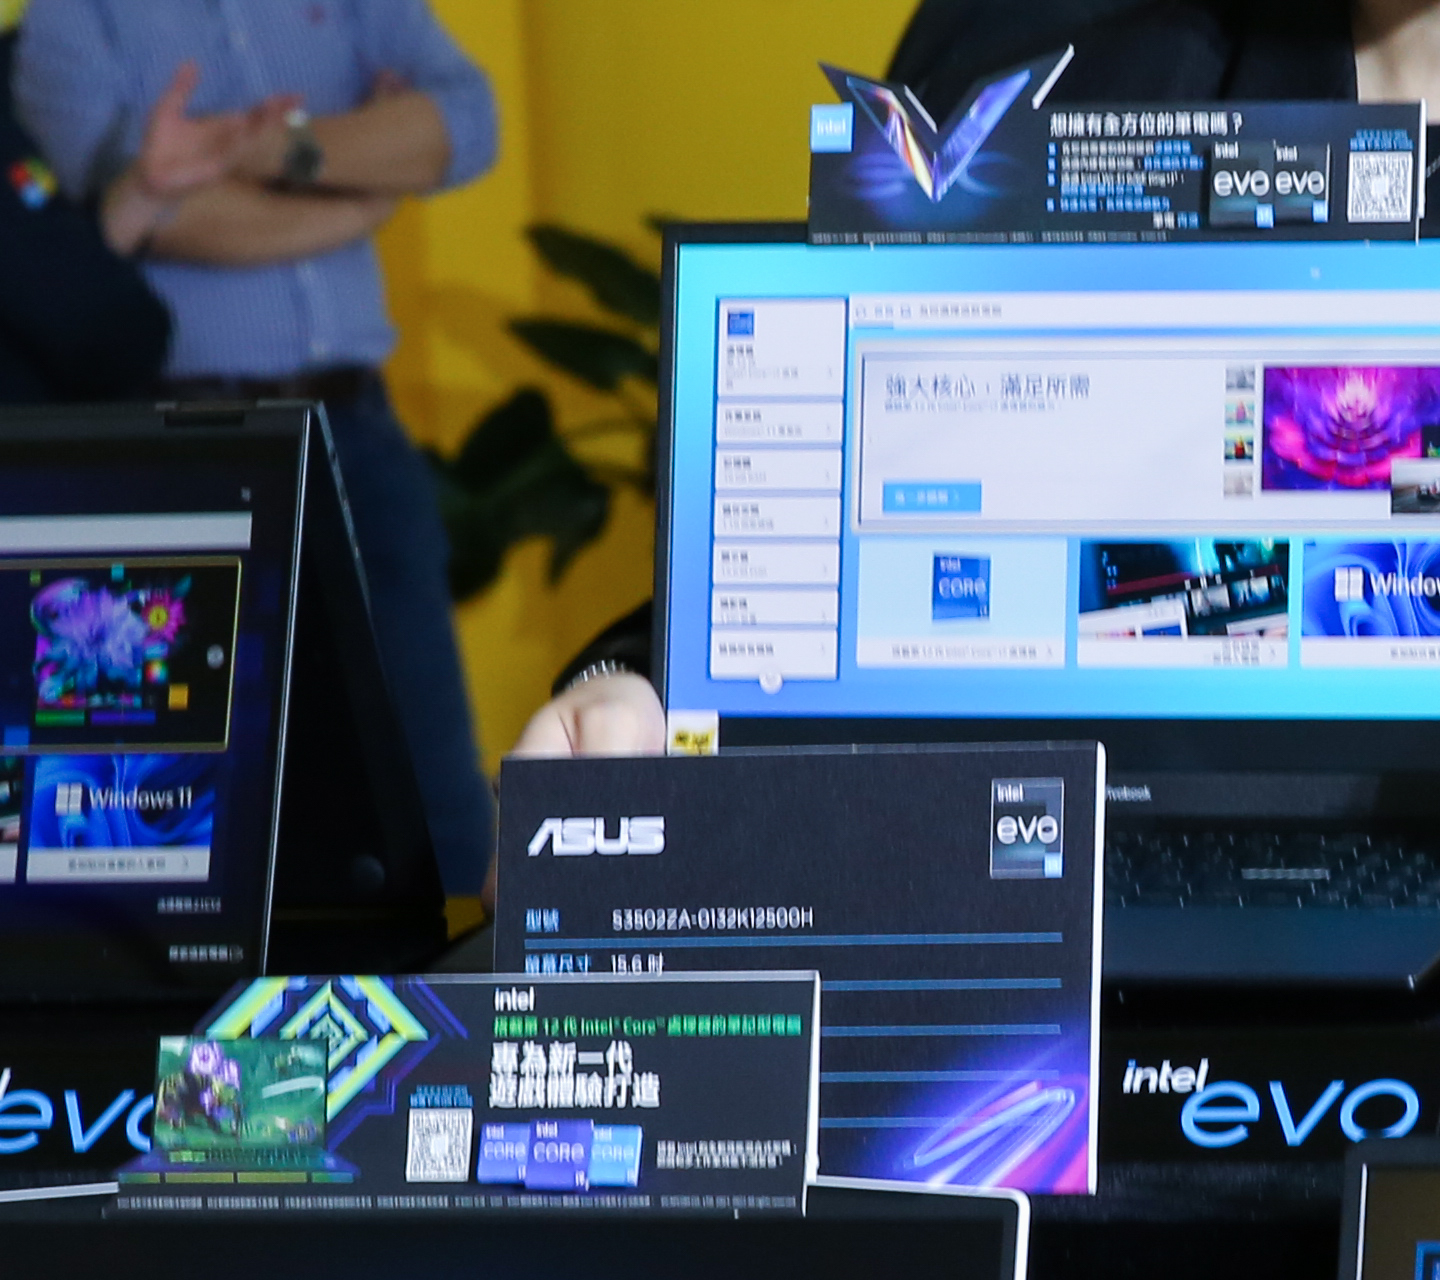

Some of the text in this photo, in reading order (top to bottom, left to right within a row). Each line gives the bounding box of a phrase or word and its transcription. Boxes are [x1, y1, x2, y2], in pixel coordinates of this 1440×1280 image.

[1214, 170, 1270, 196] evo
[1275, 170, 1324, 195] evo
[89, 786, 172, 810] Windows
[527, 816, 665, 856] ASUS
[997, 815, 1058, 845] evo
[494, 986, 535, 1011] intel
[492, 1040, 633, 1075] 專為新一代
[489, 1071, 660, 1108] 遊戲體驗打造
[1123, 1058, 1209, 1094] intel
[1181, 1078, 1419, 1148] evo
